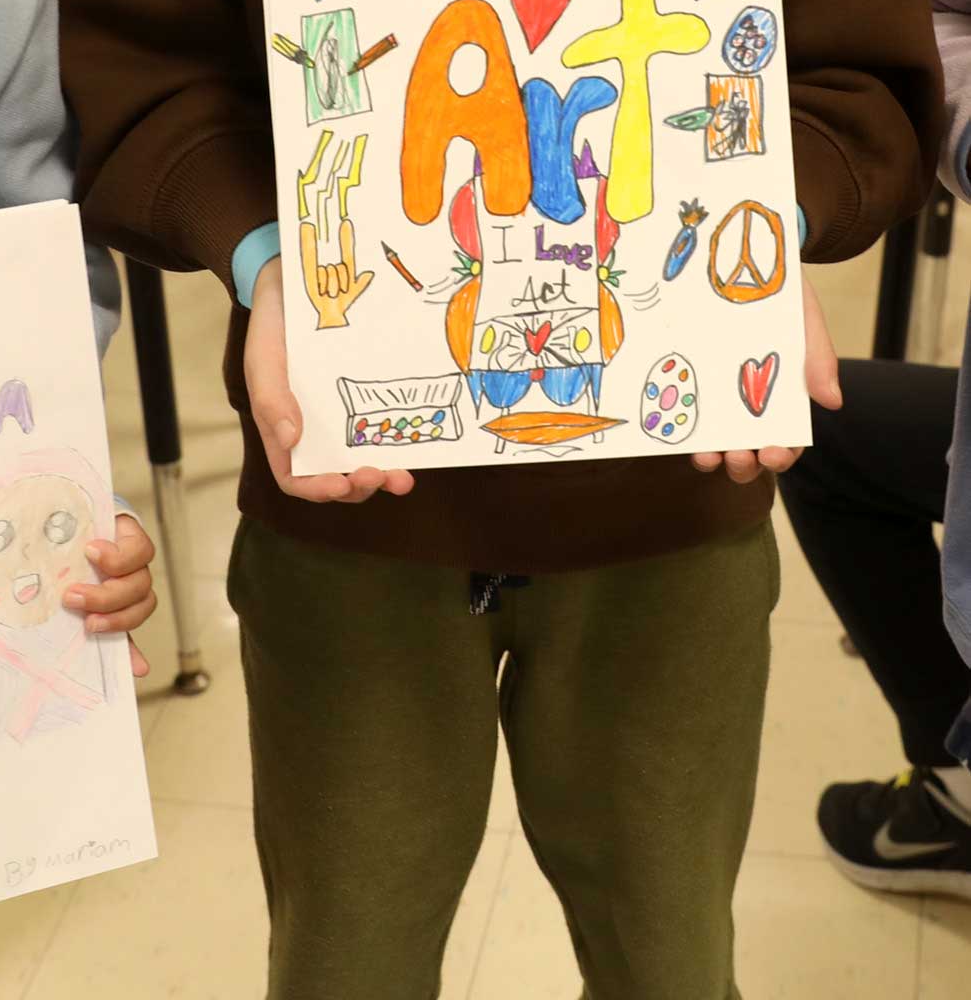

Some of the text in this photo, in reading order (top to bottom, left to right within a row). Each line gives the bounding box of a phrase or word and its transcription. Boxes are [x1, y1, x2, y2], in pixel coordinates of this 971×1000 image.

[491, 223, 593, 271] I Love
[4, 857, 37, 887] By
